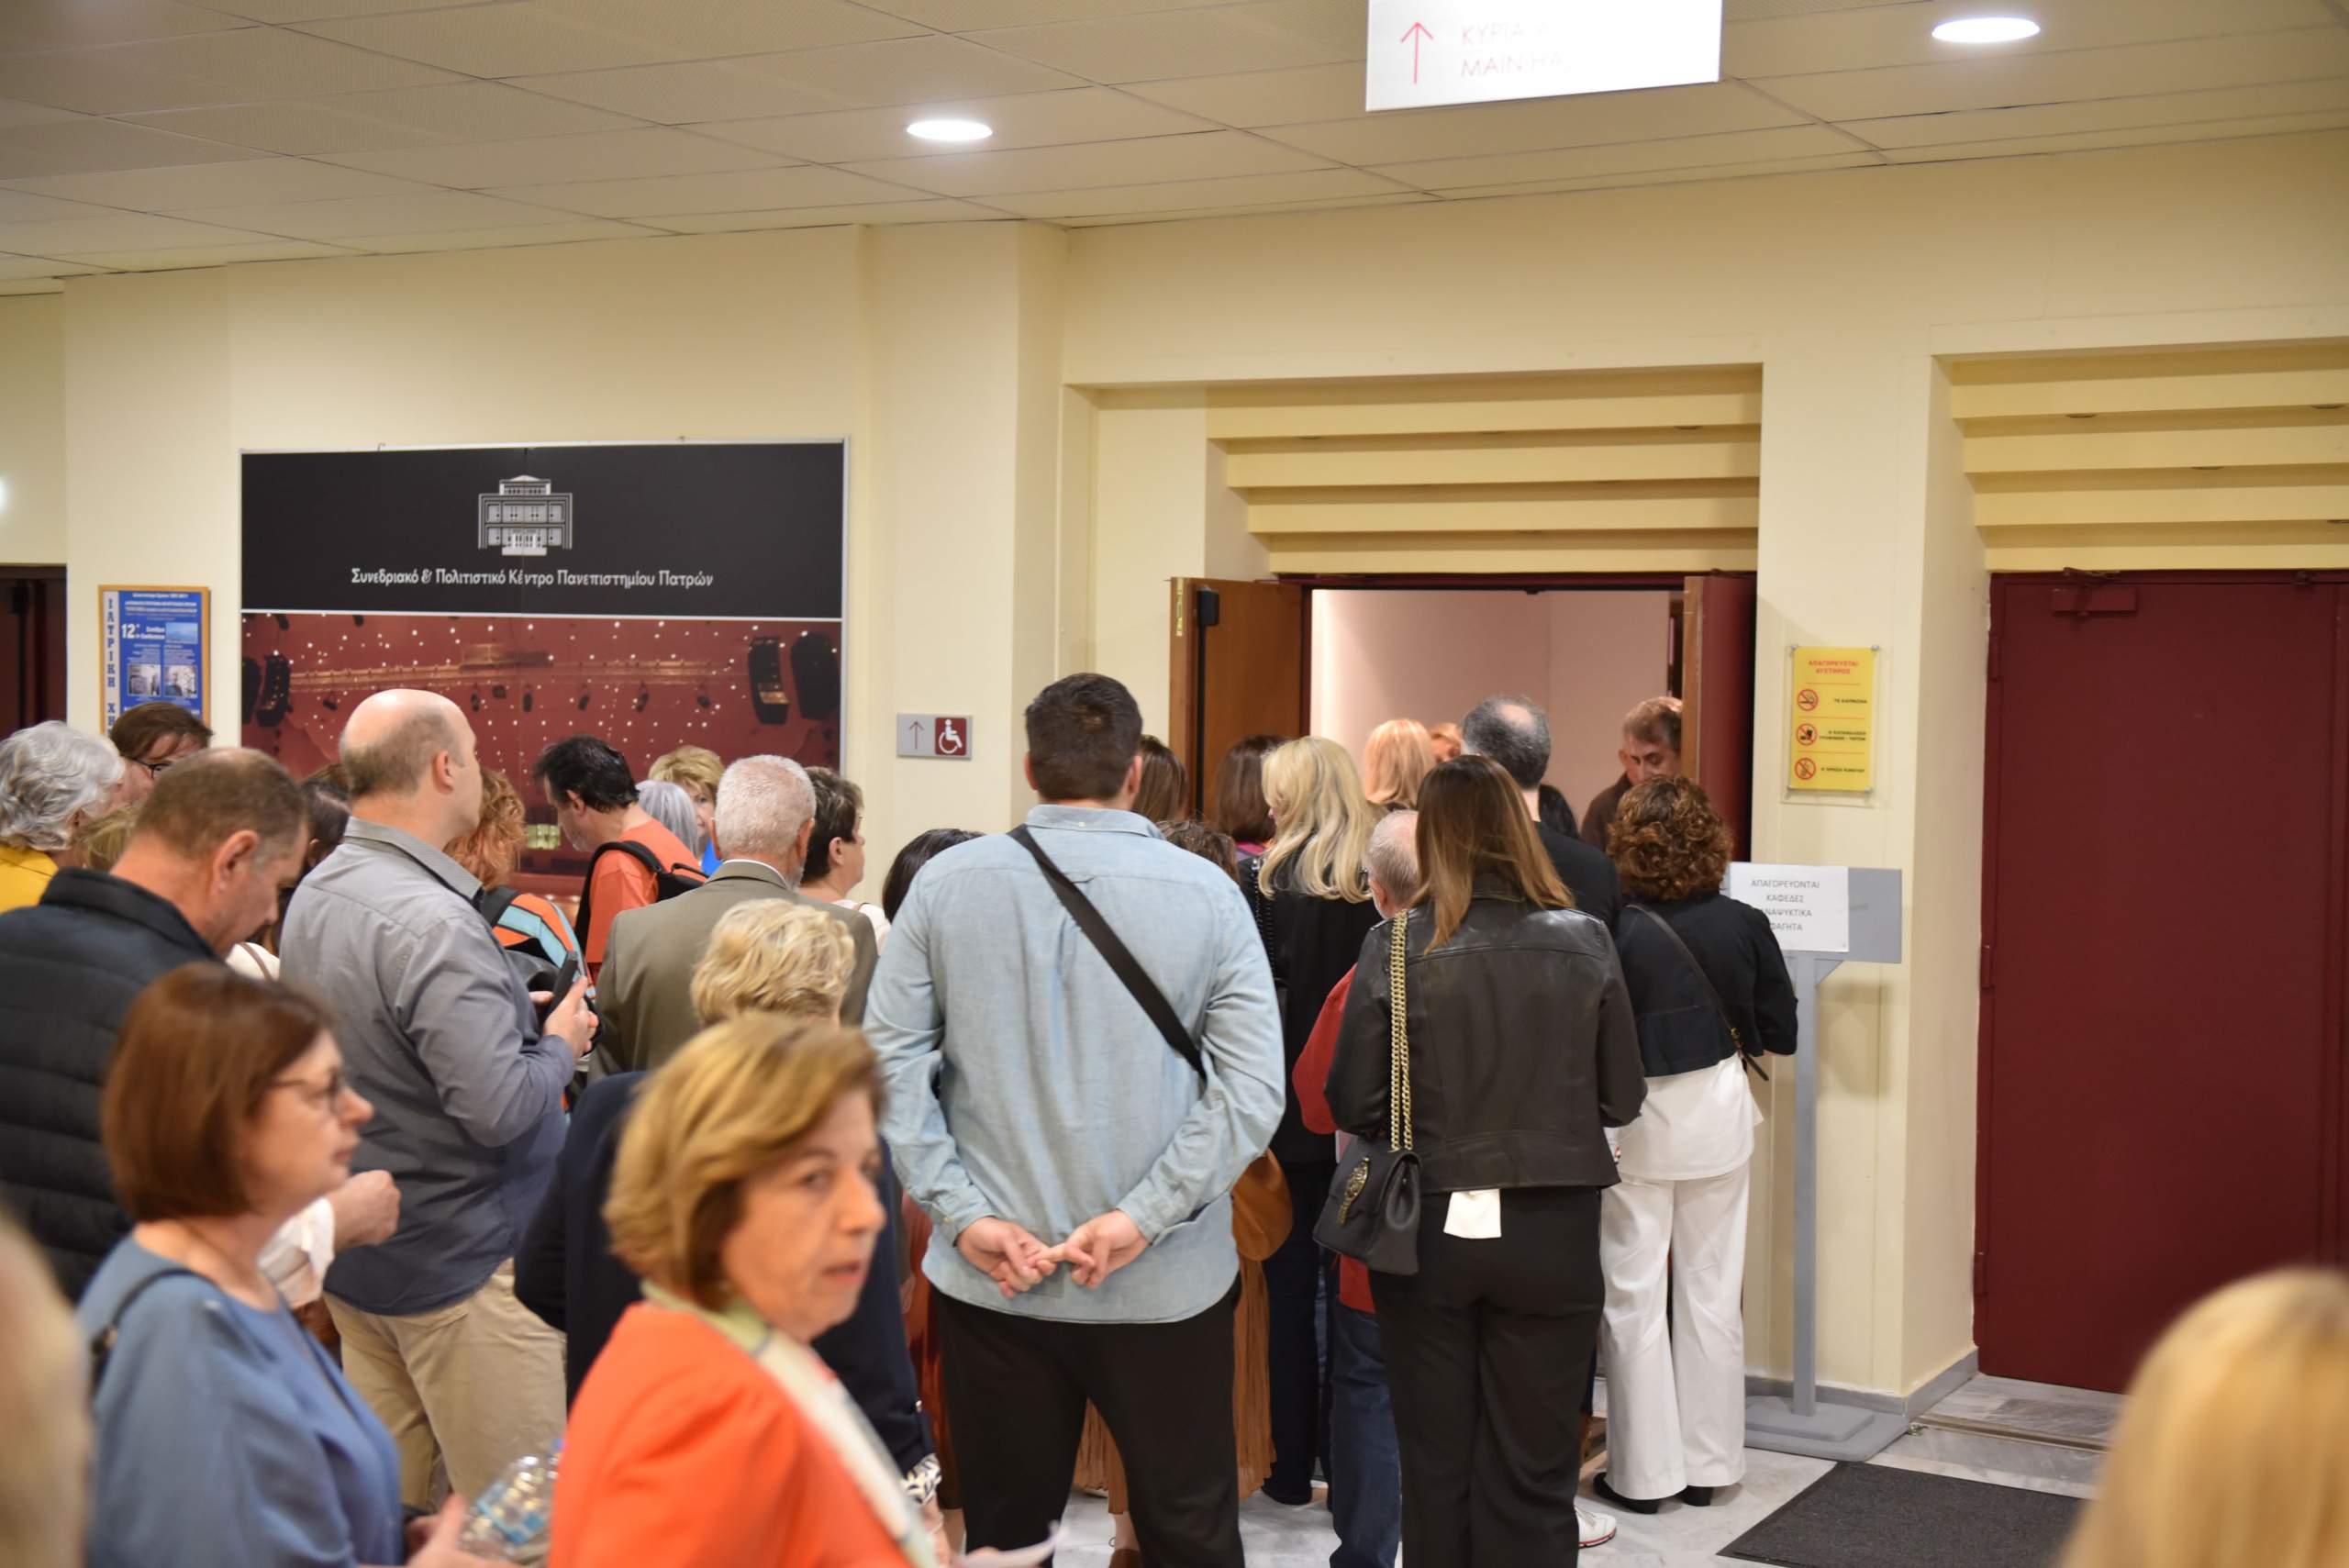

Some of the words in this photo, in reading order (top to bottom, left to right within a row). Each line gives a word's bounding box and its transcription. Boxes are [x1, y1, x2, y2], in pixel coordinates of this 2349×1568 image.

[351, 568, 419, 586] Συνεδριακό
[421, 569, 432, 584] &
[436, 568, 506, 585] Πολιτιστικό
[508, 569, 553, 588] Κέντρο
[557, 569, 655, 589] Πανεπιστημίου
[659, 570, 713, 589] Πατρών
[1751, 880, 1820, 889] ΑΠΑΓΟΡΕΥΟΝΤΑΙ
[1766, 895, 1804, 903] ΚΑΦΕΔΕΣ
